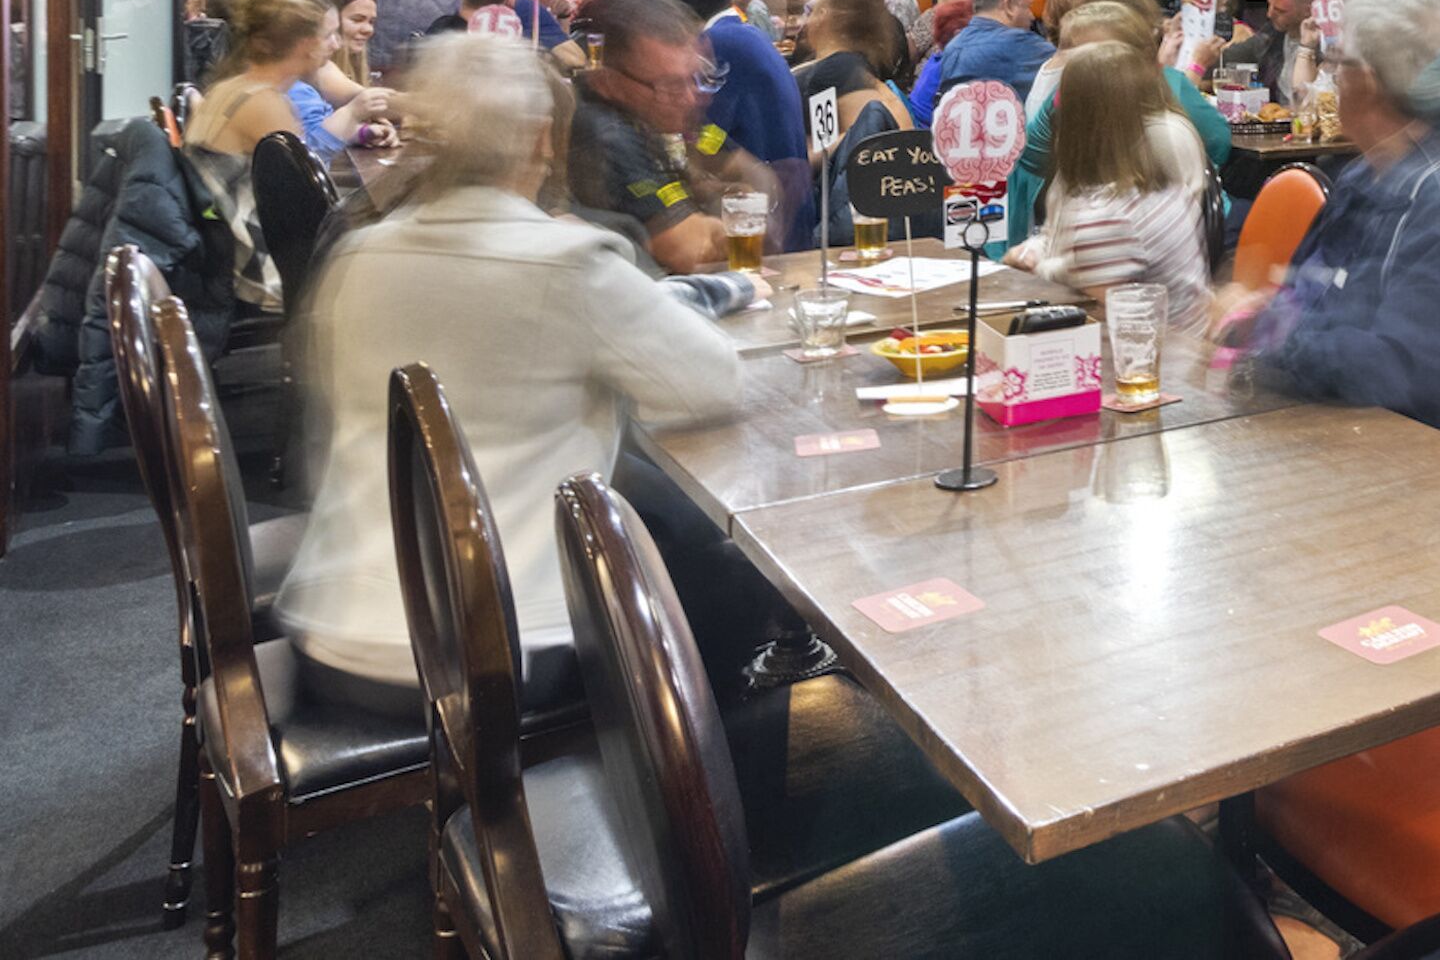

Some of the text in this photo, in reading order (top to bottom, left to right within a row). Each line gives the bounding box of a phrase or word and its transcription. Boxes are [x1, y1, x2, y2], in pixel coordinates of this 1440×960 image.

[1313, 0, 1344, 22] 16
[476, 12, 518, 40] 15
[815, 100, 834, 141] 36
[949, 100, 1017, 158] 19
[857, 146, 940, 166] EAT YOU
[880, 175, 936, 197] PEAS!
